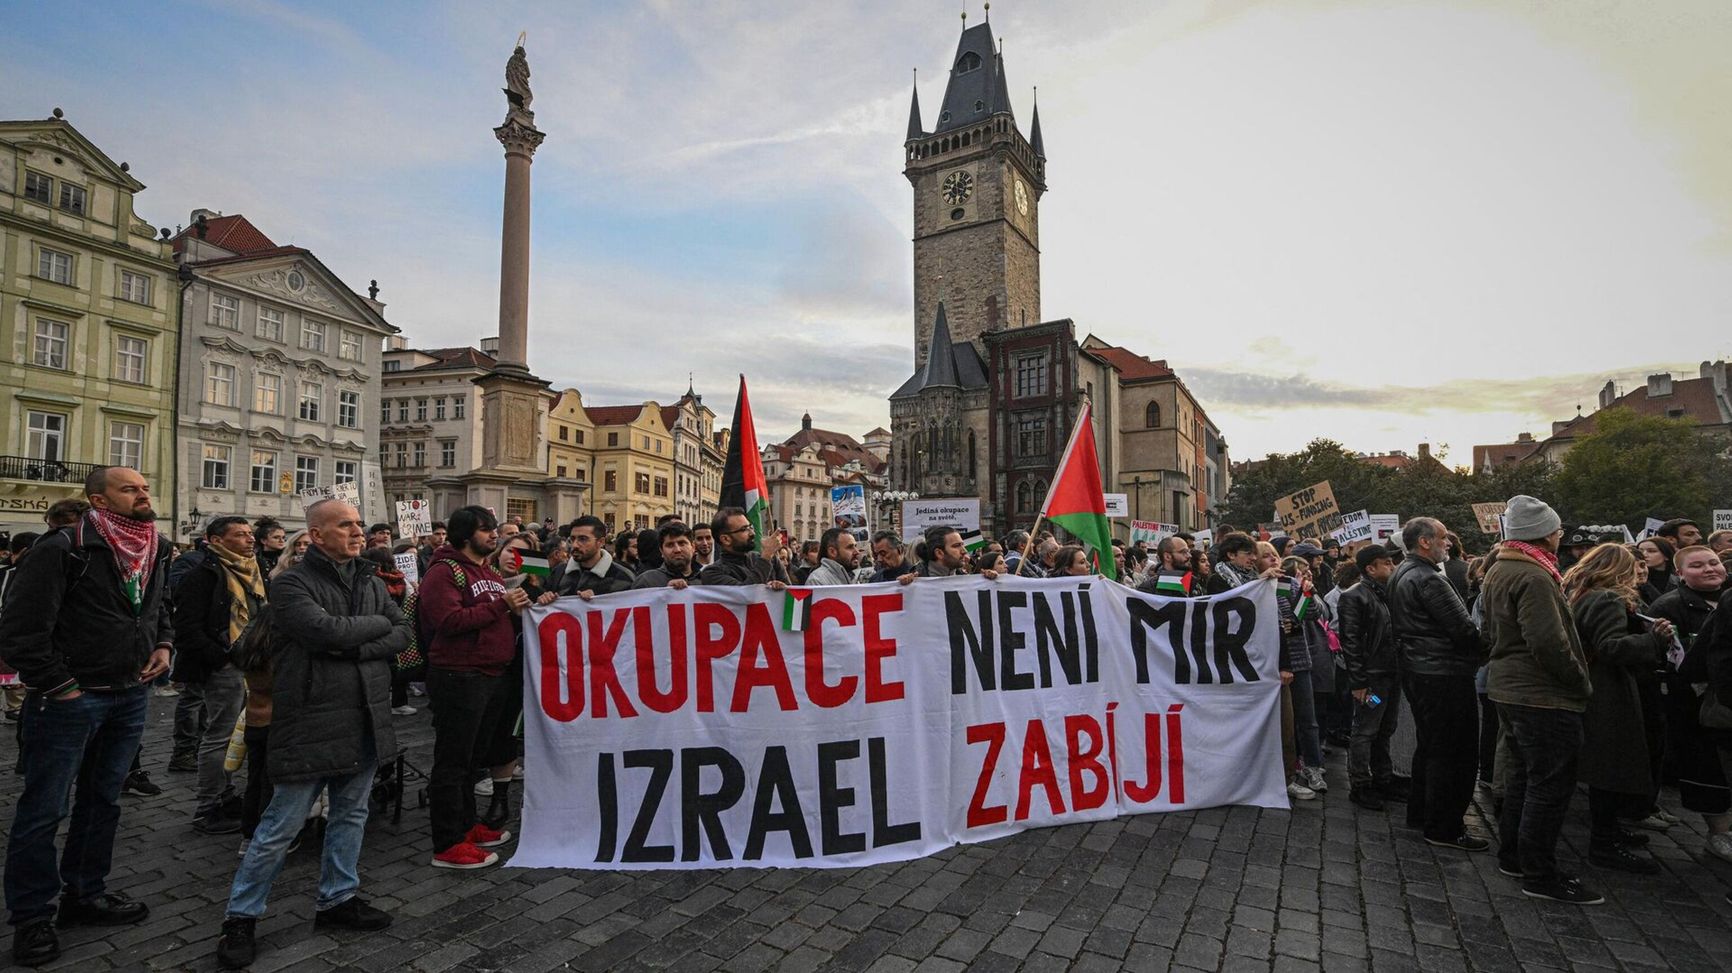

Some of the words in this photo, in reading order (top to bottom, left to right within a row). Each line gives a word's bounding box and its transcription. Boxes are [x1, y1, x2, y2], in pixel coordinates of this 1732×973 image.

[368, 471, 377, 516] HOTEL
[1291, 488, 1316, 510] STOP
[401, 501, 428, 511] STOP
[916, 507, 939, 516] Jediná
[1716, 513, 1732, 521] SVO
[1132, 520, 1159, 531] PALESTINE
[538, 593, 905, 722] OKUPACE
[944, 583, 1099, 694] NENÍ
[593, 737, 922, 863] IZRAEL
[966, 702, 1184, 828] ZABÍJÍ
